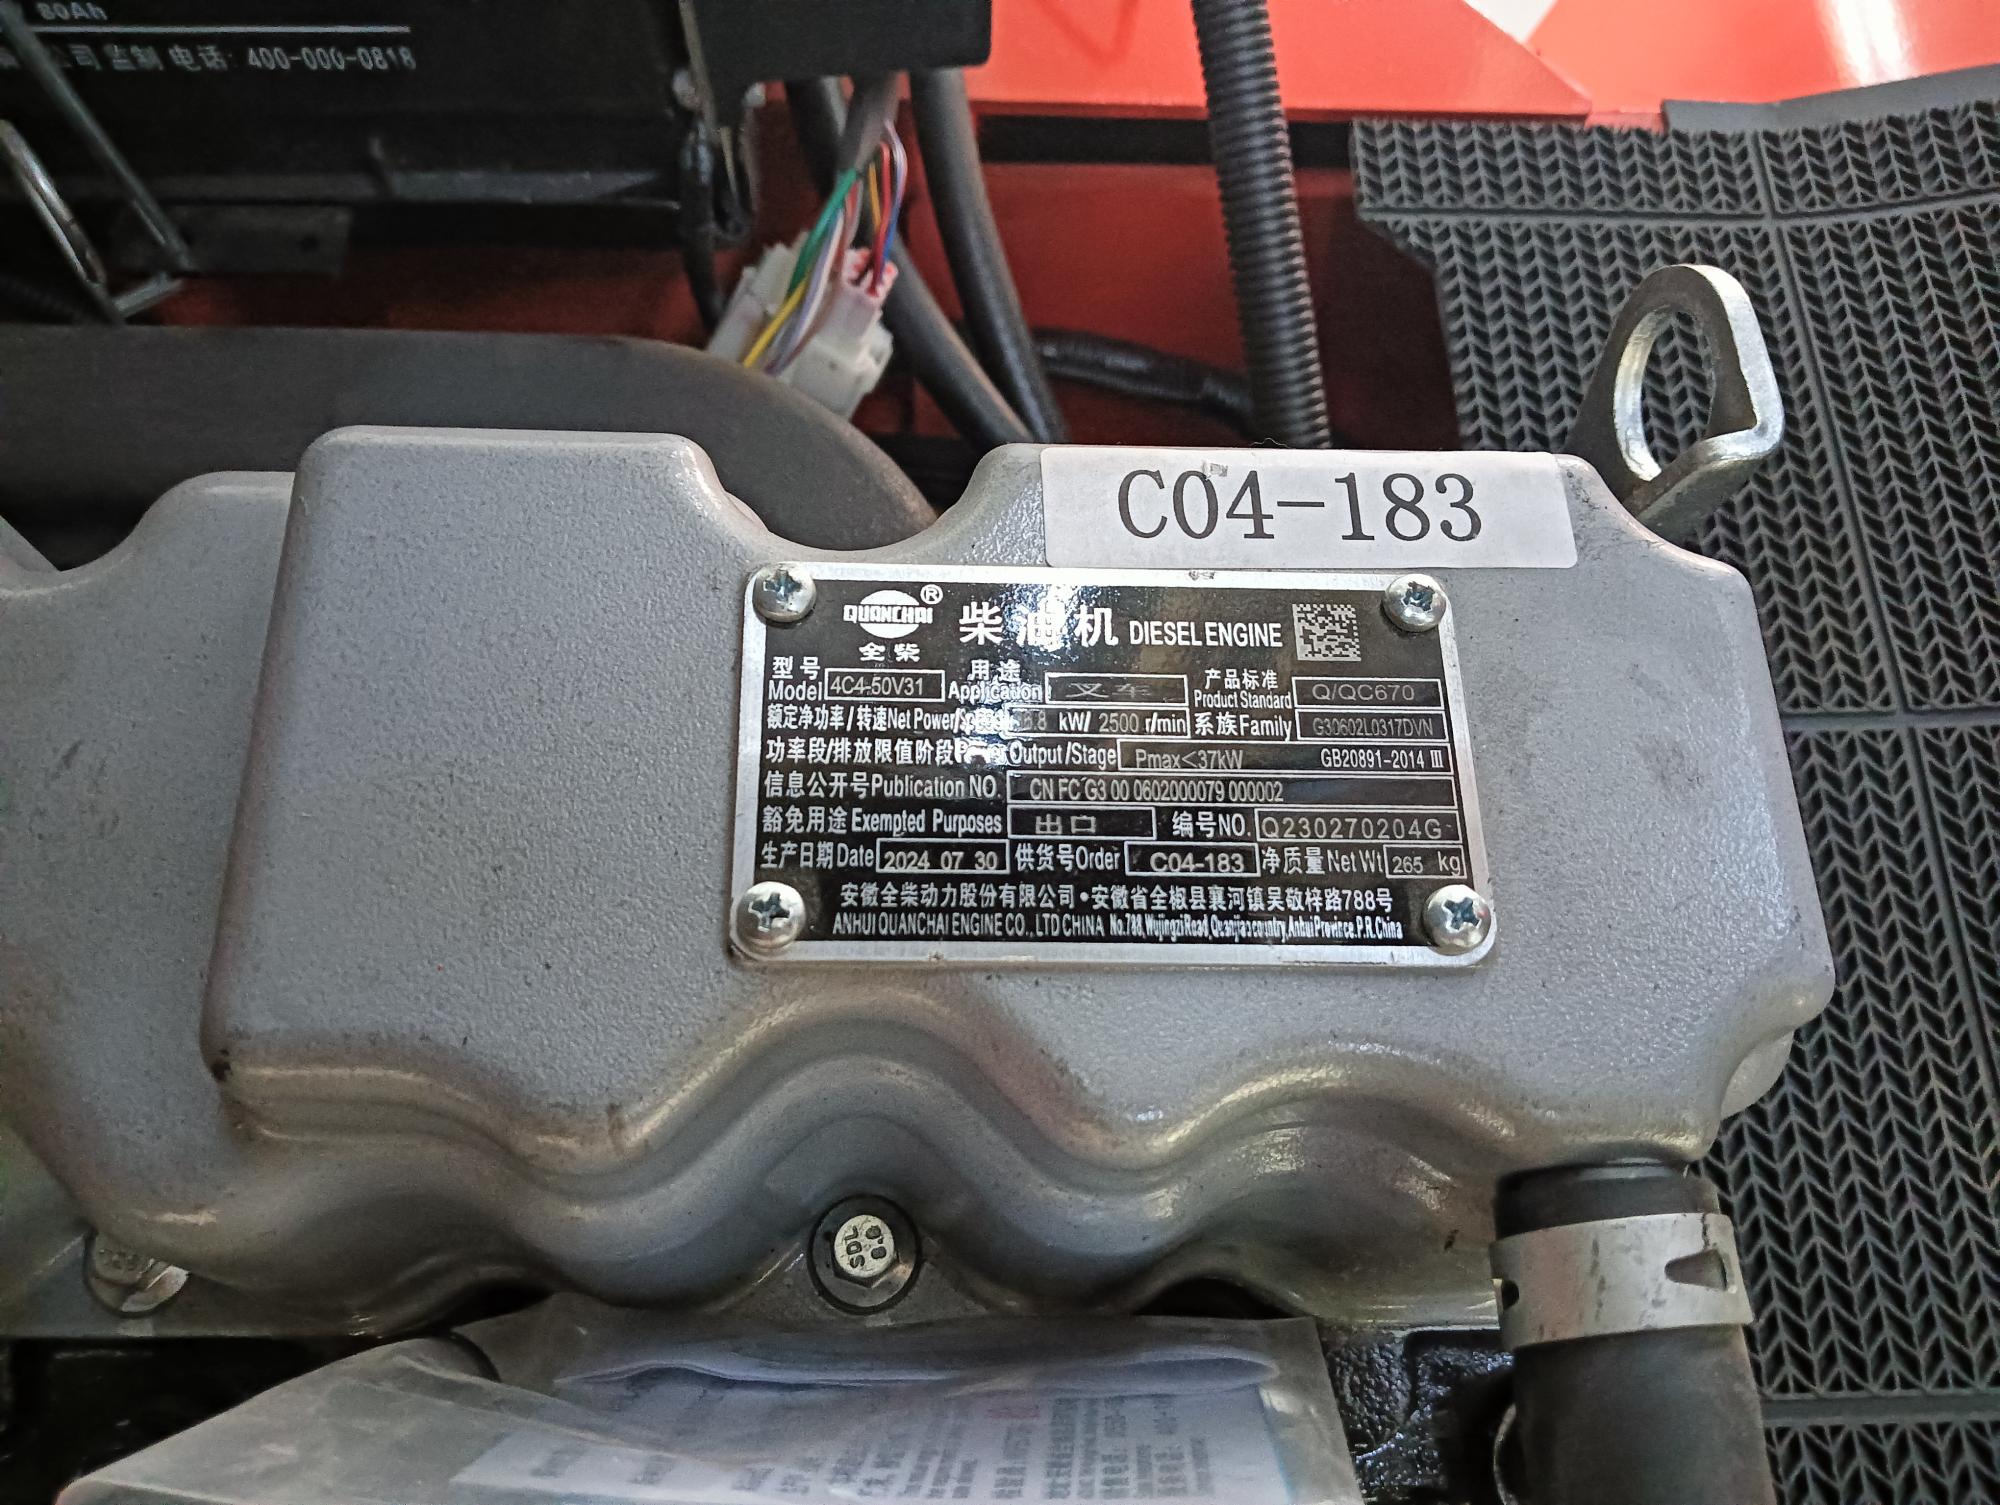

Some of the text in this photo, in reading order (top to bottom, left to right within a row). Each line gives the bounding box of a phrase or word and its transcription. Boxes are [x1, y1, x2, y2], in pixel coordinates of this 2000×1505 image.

[1117, 468, 1482, 542] C04-183
[843, 604, 933, 624] QUANCHAI
[959, 601, 1119, 652] 柴油机
[1129, 620, 1283, 648] DIESEL ENGINE
[859, 642, 920, 662] 全柴
[771, 656, 821, 680] 型号
[967, 659, 1021, 682] 用途
[1204, 667, 1279, 690] 产品标准
[768, 680, 822, 701] Model
[829, 675, 924, 696] 4C4-50V31
[947, 680, 1043, 705] Application
[1312, 683, 1415, 701] Q/QC670
[1194, 689, 1292, 709] Product Standard
[1099, 712, 1139, 733] 2500
[1145, 712, 1186, 734] r/min
[1008, 740, 1062, 768] Output
[1320, 748, 1425, 769] GB20891-2014
[871, 773, 965, 799] Publication
[969, 774, 1002, 799] NO.
[932, 808, 1003, 837] Purposes
[1035, 814, 1097, 835] 出口
[1261, 816, 1442, 840] Q230270204G
[837, 843, 874, 867] Date
[883, 850, 998, 871] 2024 07 30
[1075, 845, 1120, 871] Order
[1150, 851, 1245, 873] C04-183
[1328, 850, 1356, 873] Net
[1392, 850, 1461, 876] 265 kg
[832, 911, 876, 935] ANHUI
[878, 912, 948, 936] QUANCHAI
[951, 912, 1002, 937] ENGINE
[1061, 914, 1106, 937] CHINA
